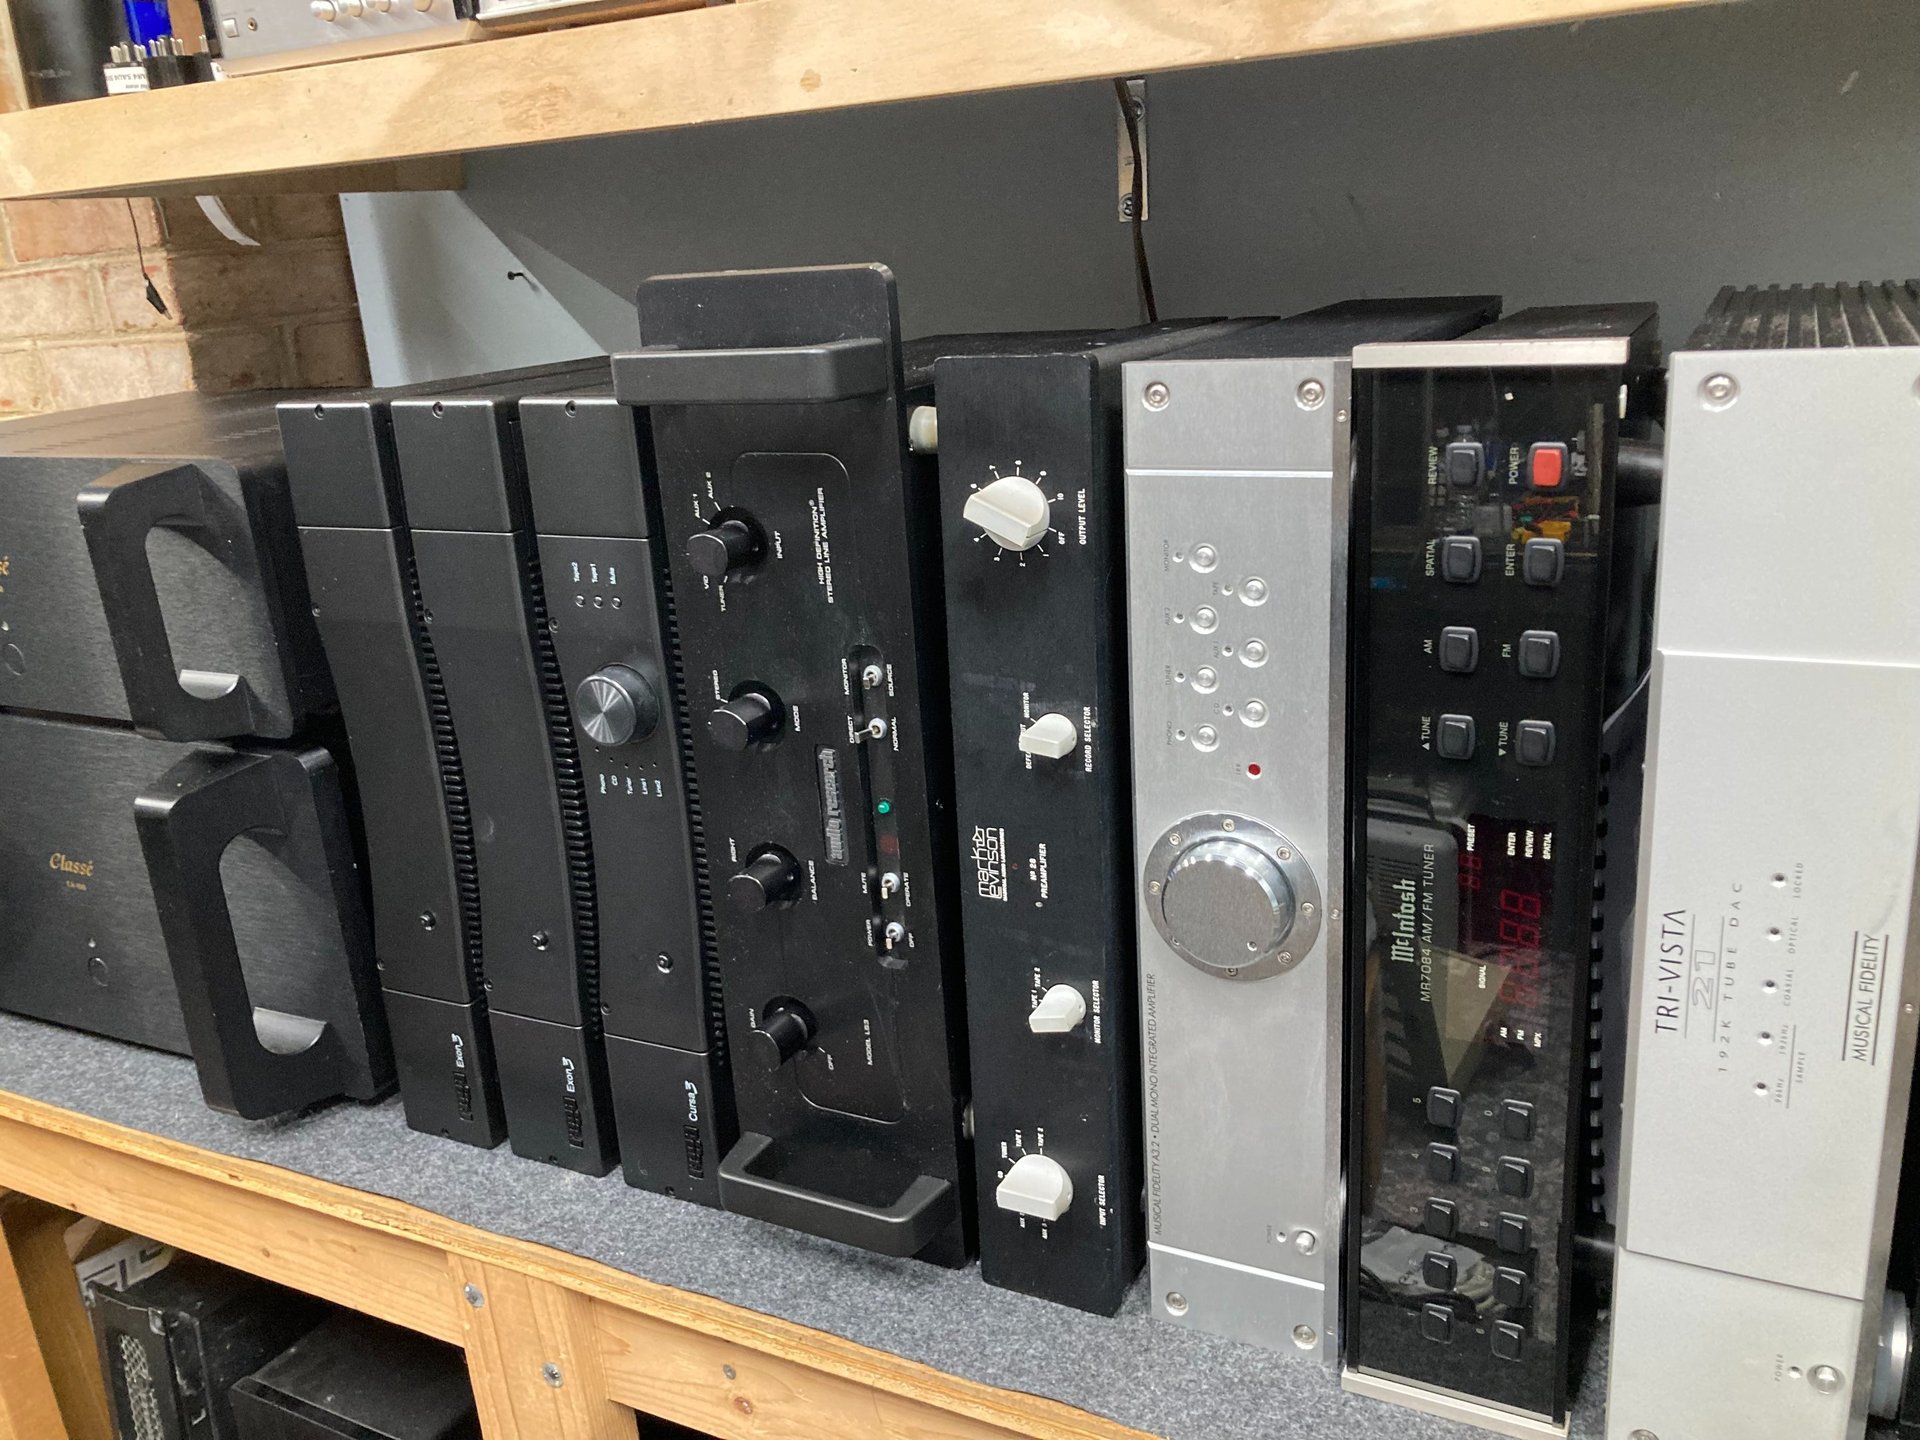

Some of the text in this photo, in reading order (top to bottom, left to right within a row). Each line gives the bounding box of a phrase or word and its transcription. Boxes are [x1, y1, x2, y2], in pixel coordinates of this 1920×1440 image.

[1427, 446, 1438, 485] REVIEW
[1508, 446, 1519, 485] POWER
[1057, 492, 1065, 500] 10
[1077, 488, 1087, 545] OUTPUT LEVEL
[774, 530, 783, 559] INPUT
[817, 487, 834, 604] STEREO LINE AMPLIFIER
[1058, 531, 1066, 545] OFF
[817, 562, 825, 585] HIGH
[1425, 538, 1436, 577] SPATIAL
[1505, 543, 1515, 577] ENTER
[1423, 639, 1432, 654] AM
[1502, 643, 1512, 658] FM
[712, 669, 721, 700] STEREO
[841, 658, 850, 696] MONITOR
[886, 664, 895, 697] SOURCE
[1022, 691, 1030, 718] MONITOR
[1213, 702, 1220, 714] CD
[847, 715, 855, 744] DIRECT
[891, 717, 899, 752] NORMAL
[1083, 706, 1093, 773] RECORD SELECTOR
[1421, 716, 1431, 741] TUNE
[1498, 721, 1509, 747] TUNE
[611, 775, 618, 786] CD
[818, 747, 840, 816] research
[1466, 823, 1475, 852] PRESET
[1507, 832, 1516, 857] ENTER
[1525, 829, 1534, 858] REVIEW
[1542, 832, 1552, 860] SPATIAL
[50, 853, 94, 877] Classé
[1029, 858, 1037, 869] 28
[1038, 843, 1048, 899] PREAMPLIFIER
[808, 860, 818, 901] BALANCE
[903, 872, 912, 907] OPERATE
[1792, 862, 1803, 899] LOCKED
[865, 919, 874, 947] POWER
[1390, 878, 1416, 963] McIntosh
[1420, 843, 1435, 1002] MR7084 AM/FM TUNER
[1787, 916, 1799, 954] OPTICAL
[1478, 964, 1486, 989] SIGNAL
[1654, 908, 1687, 1034] TRI-VISTA
[1691, 949, 1716, 1010] 21
[1718, 882, 1743, 1073] 192K TUBE DAC
[1783, 969, 1795, 1007] COAXIAL
[1851, 933, 1880, 1062] MUSICAL FIDELITY
[1092, 980, 1102, 1044] MONITOR SELECTOR
[1500, 1026, 1507, 1038] AM
[1517, 1029, 1524, 1041] FM
[1534, 1032, 1542, 1048] MPX
[865, 1037, 873, 1066] MODEL
[1795, 1051, 1806, 1084] SAMPLE
[1146, 973, 1162, 1236] MUSICAL FIDELITY A3.2 DUAL MONO INTEGRATED AMPLIFIER
[1098, 1175, 1107, 1227] INPUT SELECTOR
[1774, 1353, 1784, 1382] POWER
